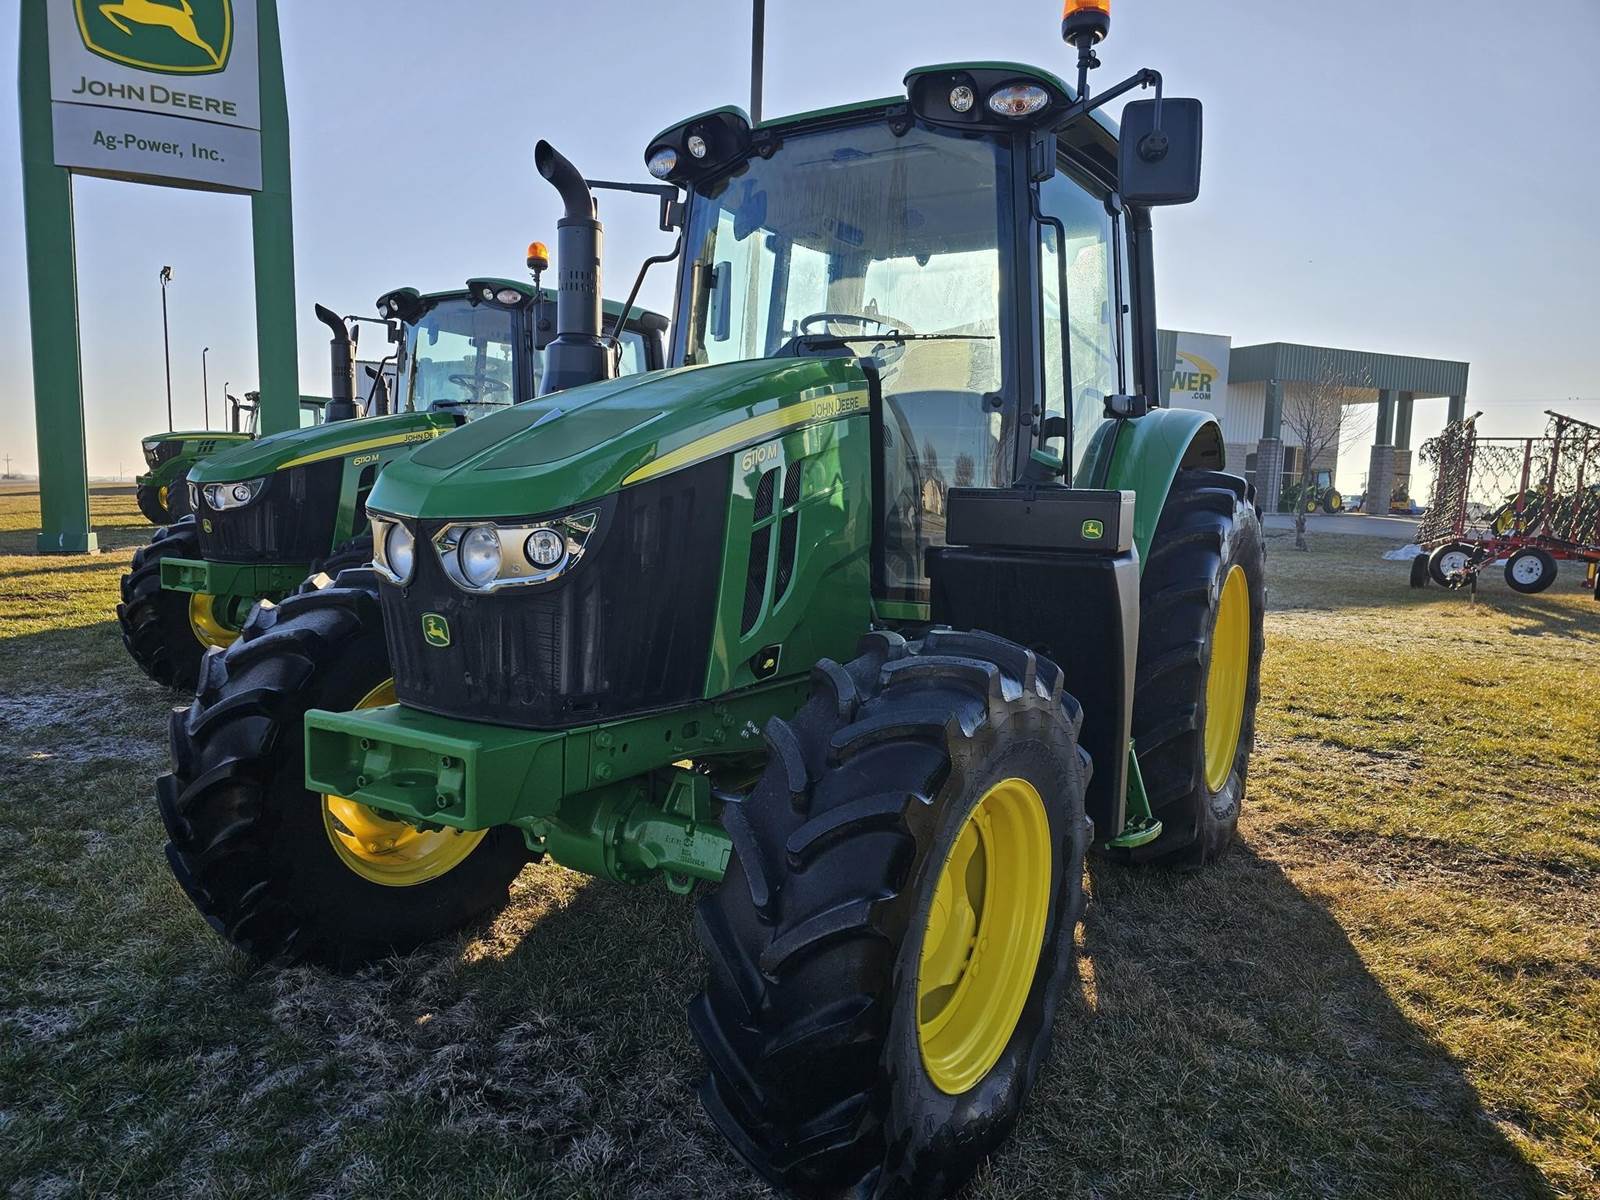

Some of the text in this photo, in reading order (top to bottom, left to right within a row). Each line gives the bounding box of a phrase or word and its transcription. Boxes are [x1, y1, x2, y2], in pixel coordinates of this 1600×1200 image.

[72, 76, 237, 117] JOHN DEERE
[93, 130, 225, 163] Ag-Power, Inc.
[811, 396, 859, 418] JOHN DEERE
[404, 434, 424, 442] JOHN
